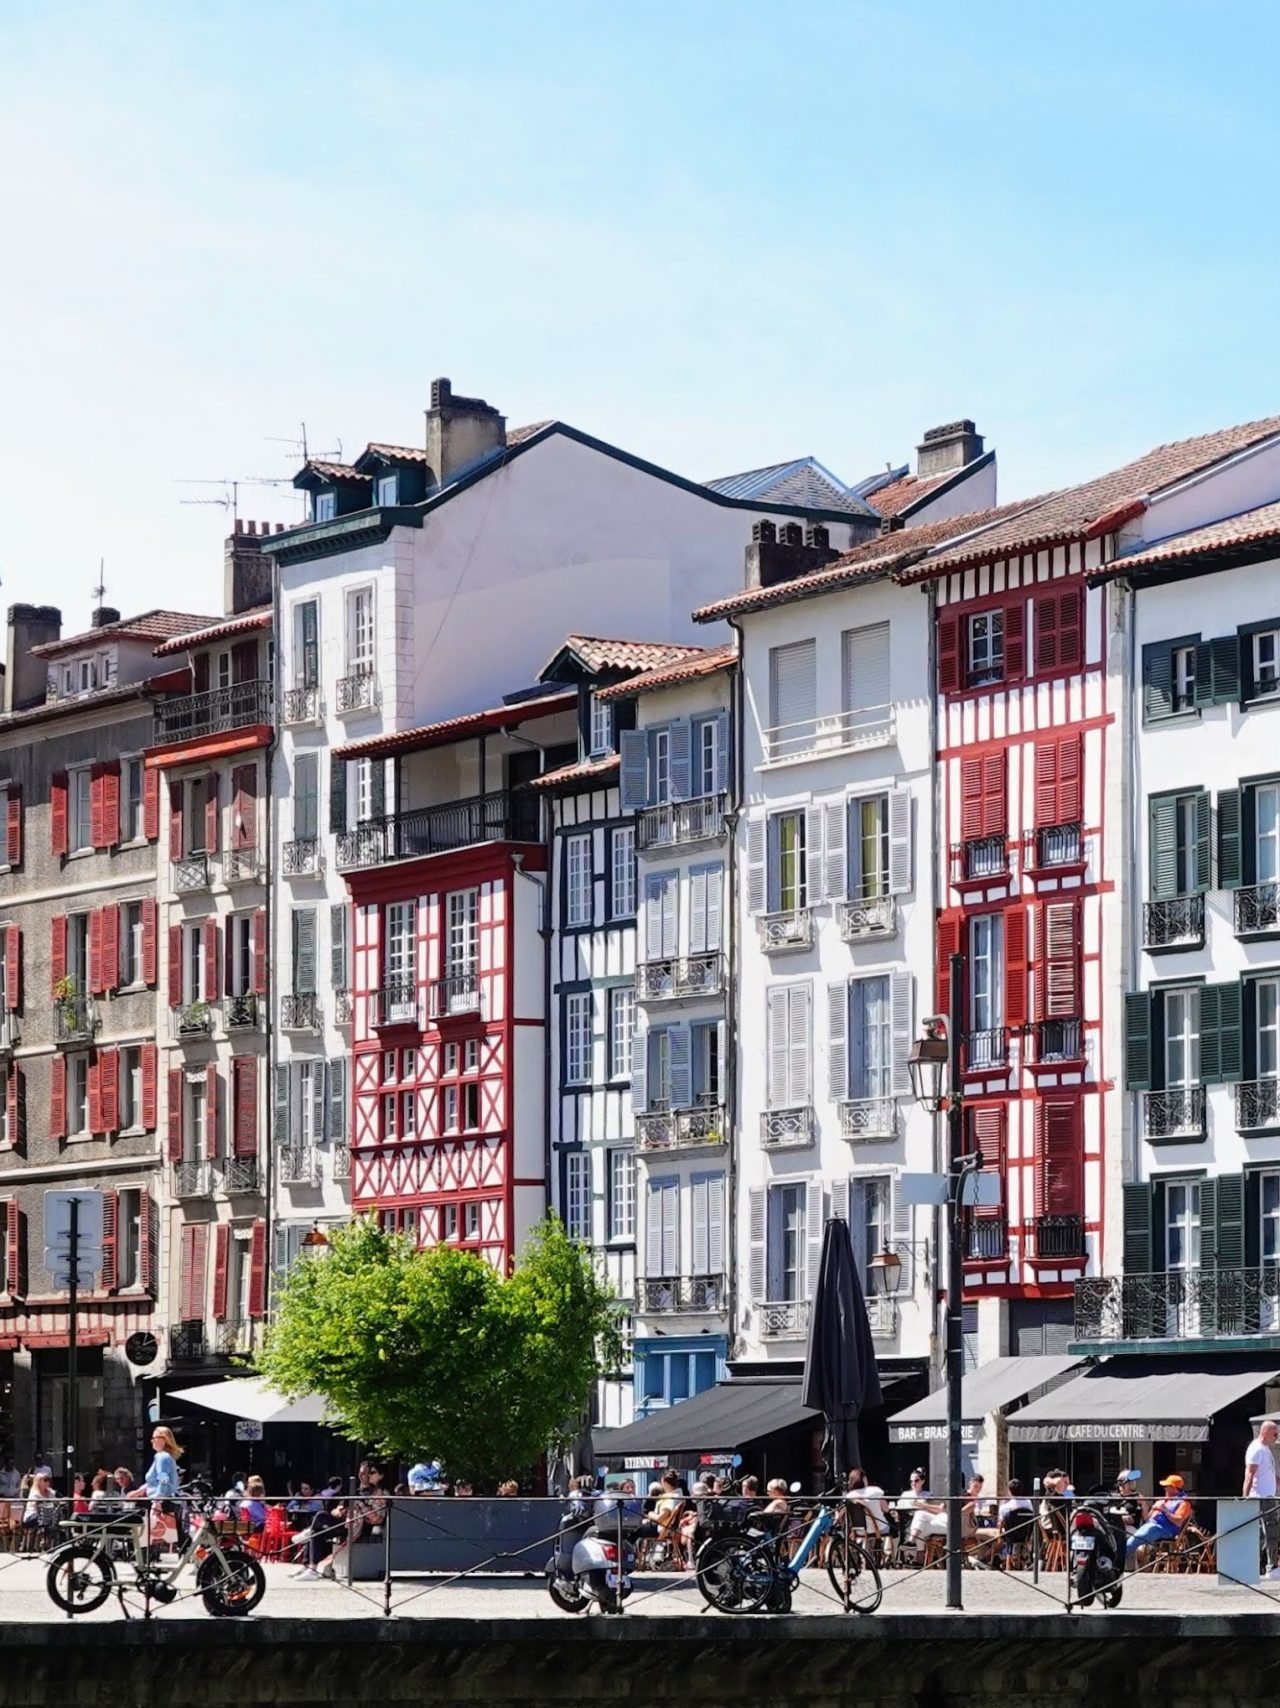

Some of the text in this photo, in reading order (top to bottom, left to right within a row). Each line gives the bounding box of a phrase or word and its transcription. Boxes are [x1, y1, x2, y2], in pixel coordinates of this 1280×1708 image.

[898, 1427, 917, 1439] BAR
[924, 1425, 974, 1439] BRASRIE
[1093, 1424, 1108, 1438] DU
[1109, 1424, 1144, 1438] CENTRE
